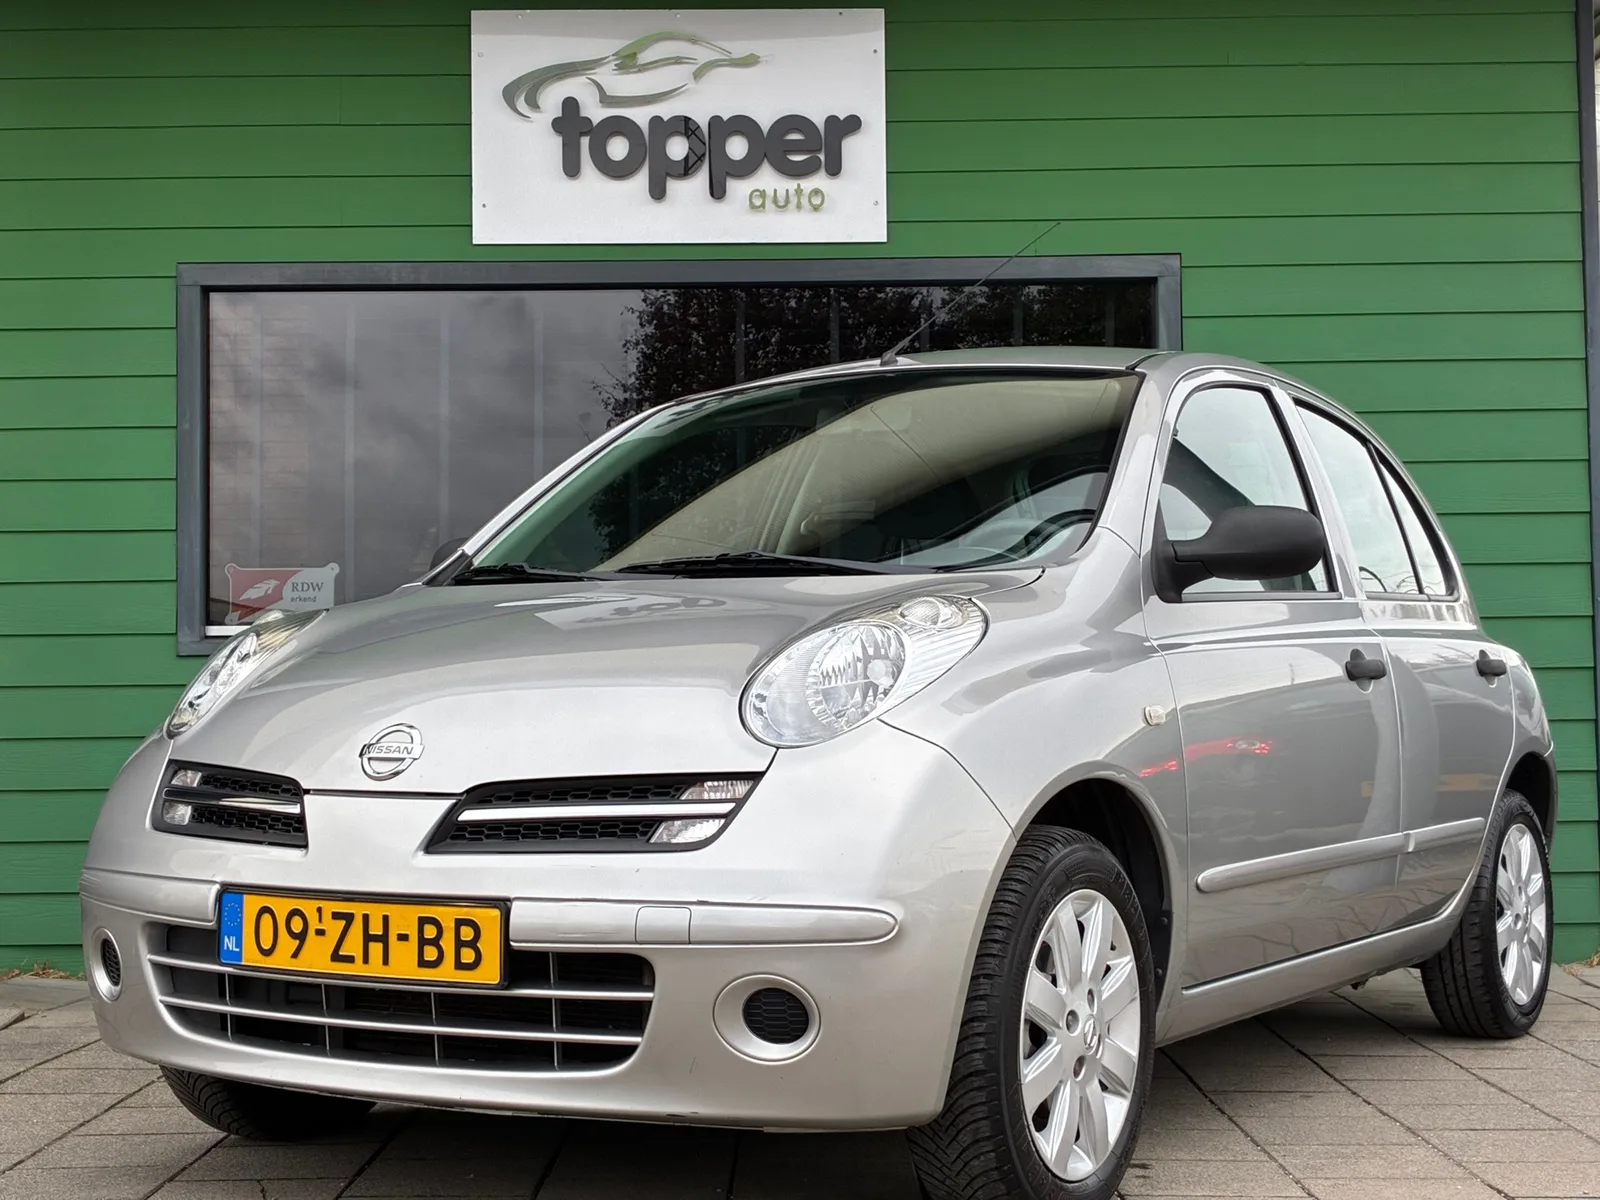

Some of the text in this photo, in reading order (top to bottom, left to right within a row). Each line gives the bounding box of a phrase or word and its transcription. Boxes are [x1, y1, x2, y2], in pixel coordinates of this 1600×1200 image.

[551, 96, 862, 200] topper
[748, 183, 825, 211] auto
[291, 582, 324, 593] RDW
[365, 745, 414, 755] NISSAN
[223, 935, 240, 951] NL
